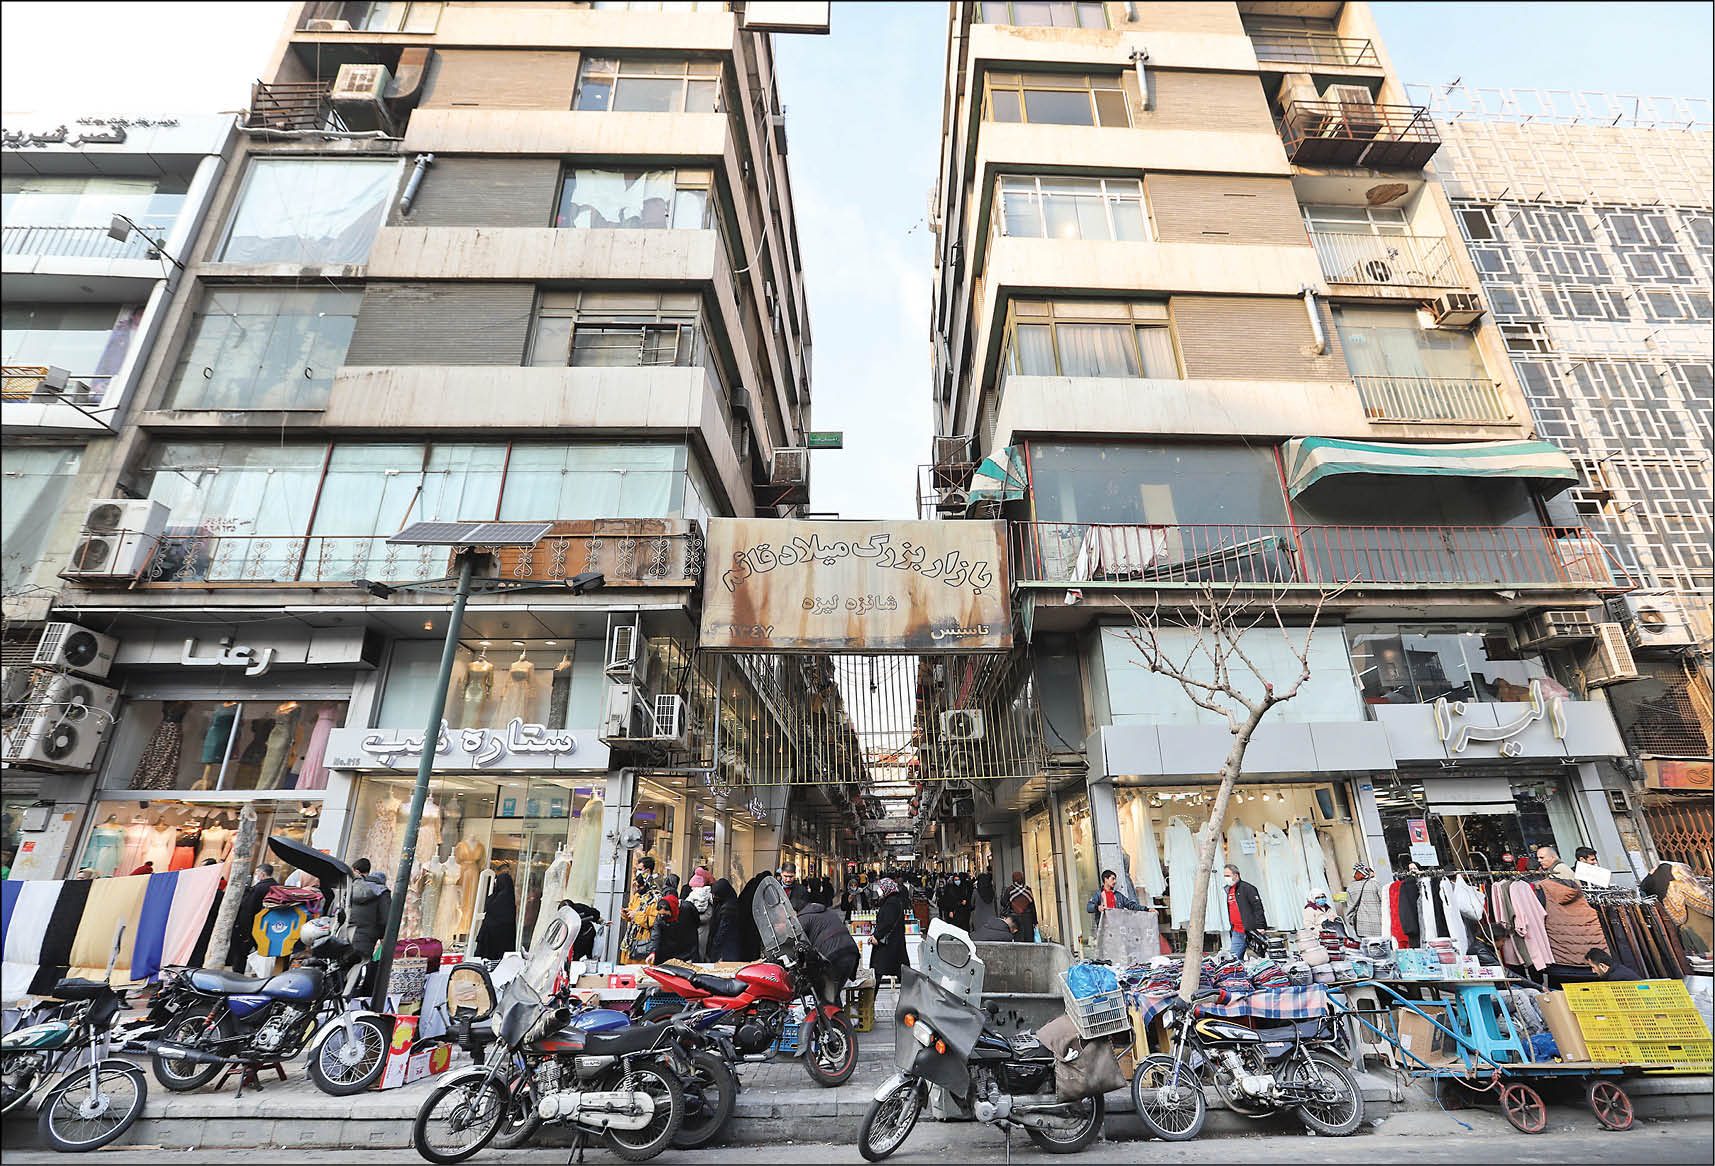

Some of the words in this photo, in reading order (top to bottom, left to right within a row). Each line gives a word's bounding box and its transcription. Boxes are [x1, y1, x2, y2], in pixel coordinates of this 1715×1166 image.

[722, 543, 778, 593] قائم
[778, 533, 850, 566] میلاد
[851, 533, 926, 570] بزرگ
[922, 550, 993, 595] بازار
[801, 594, 839, 615] لیزه
[844, 597, 898, 615] شانزه
[930, 624, 991, 640] تاسیس
[181, 637, 276, 676] رعنا
[461, 717, 577, 769] ستاره
